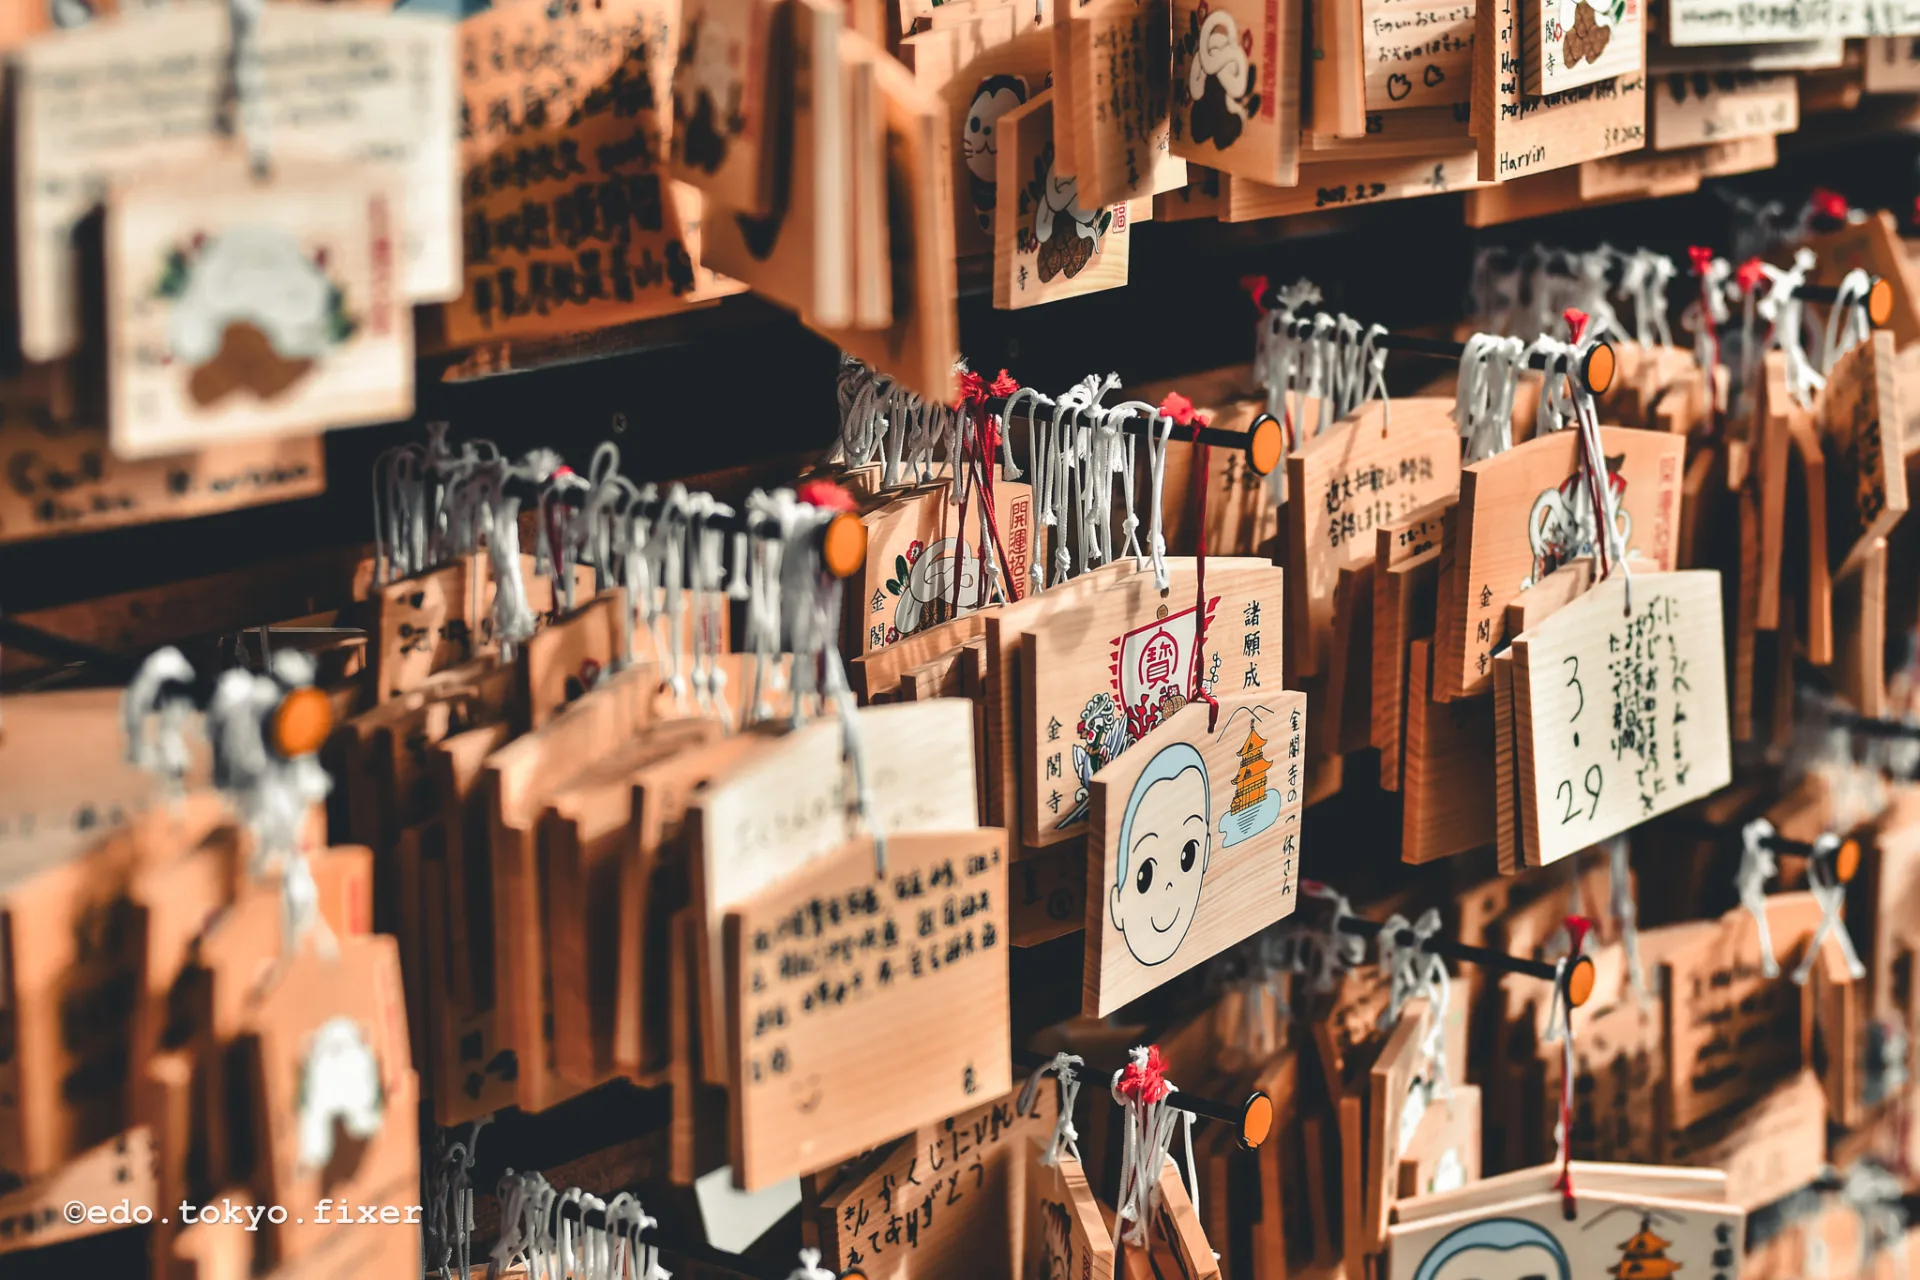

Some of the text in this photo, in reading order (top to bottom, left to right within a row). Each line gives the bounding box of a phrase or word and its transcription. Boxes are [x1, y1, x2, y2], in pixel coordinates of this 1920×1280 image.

[1500, 144, 1546, 174] Harvin
[870, 588, 887, 650] 金閣
[1242, 599, 1262, 690] 諸願成
[1474, 584, 1493, 675] 金閣寺
[1045, 714, 1064, 815] 金閣寺
